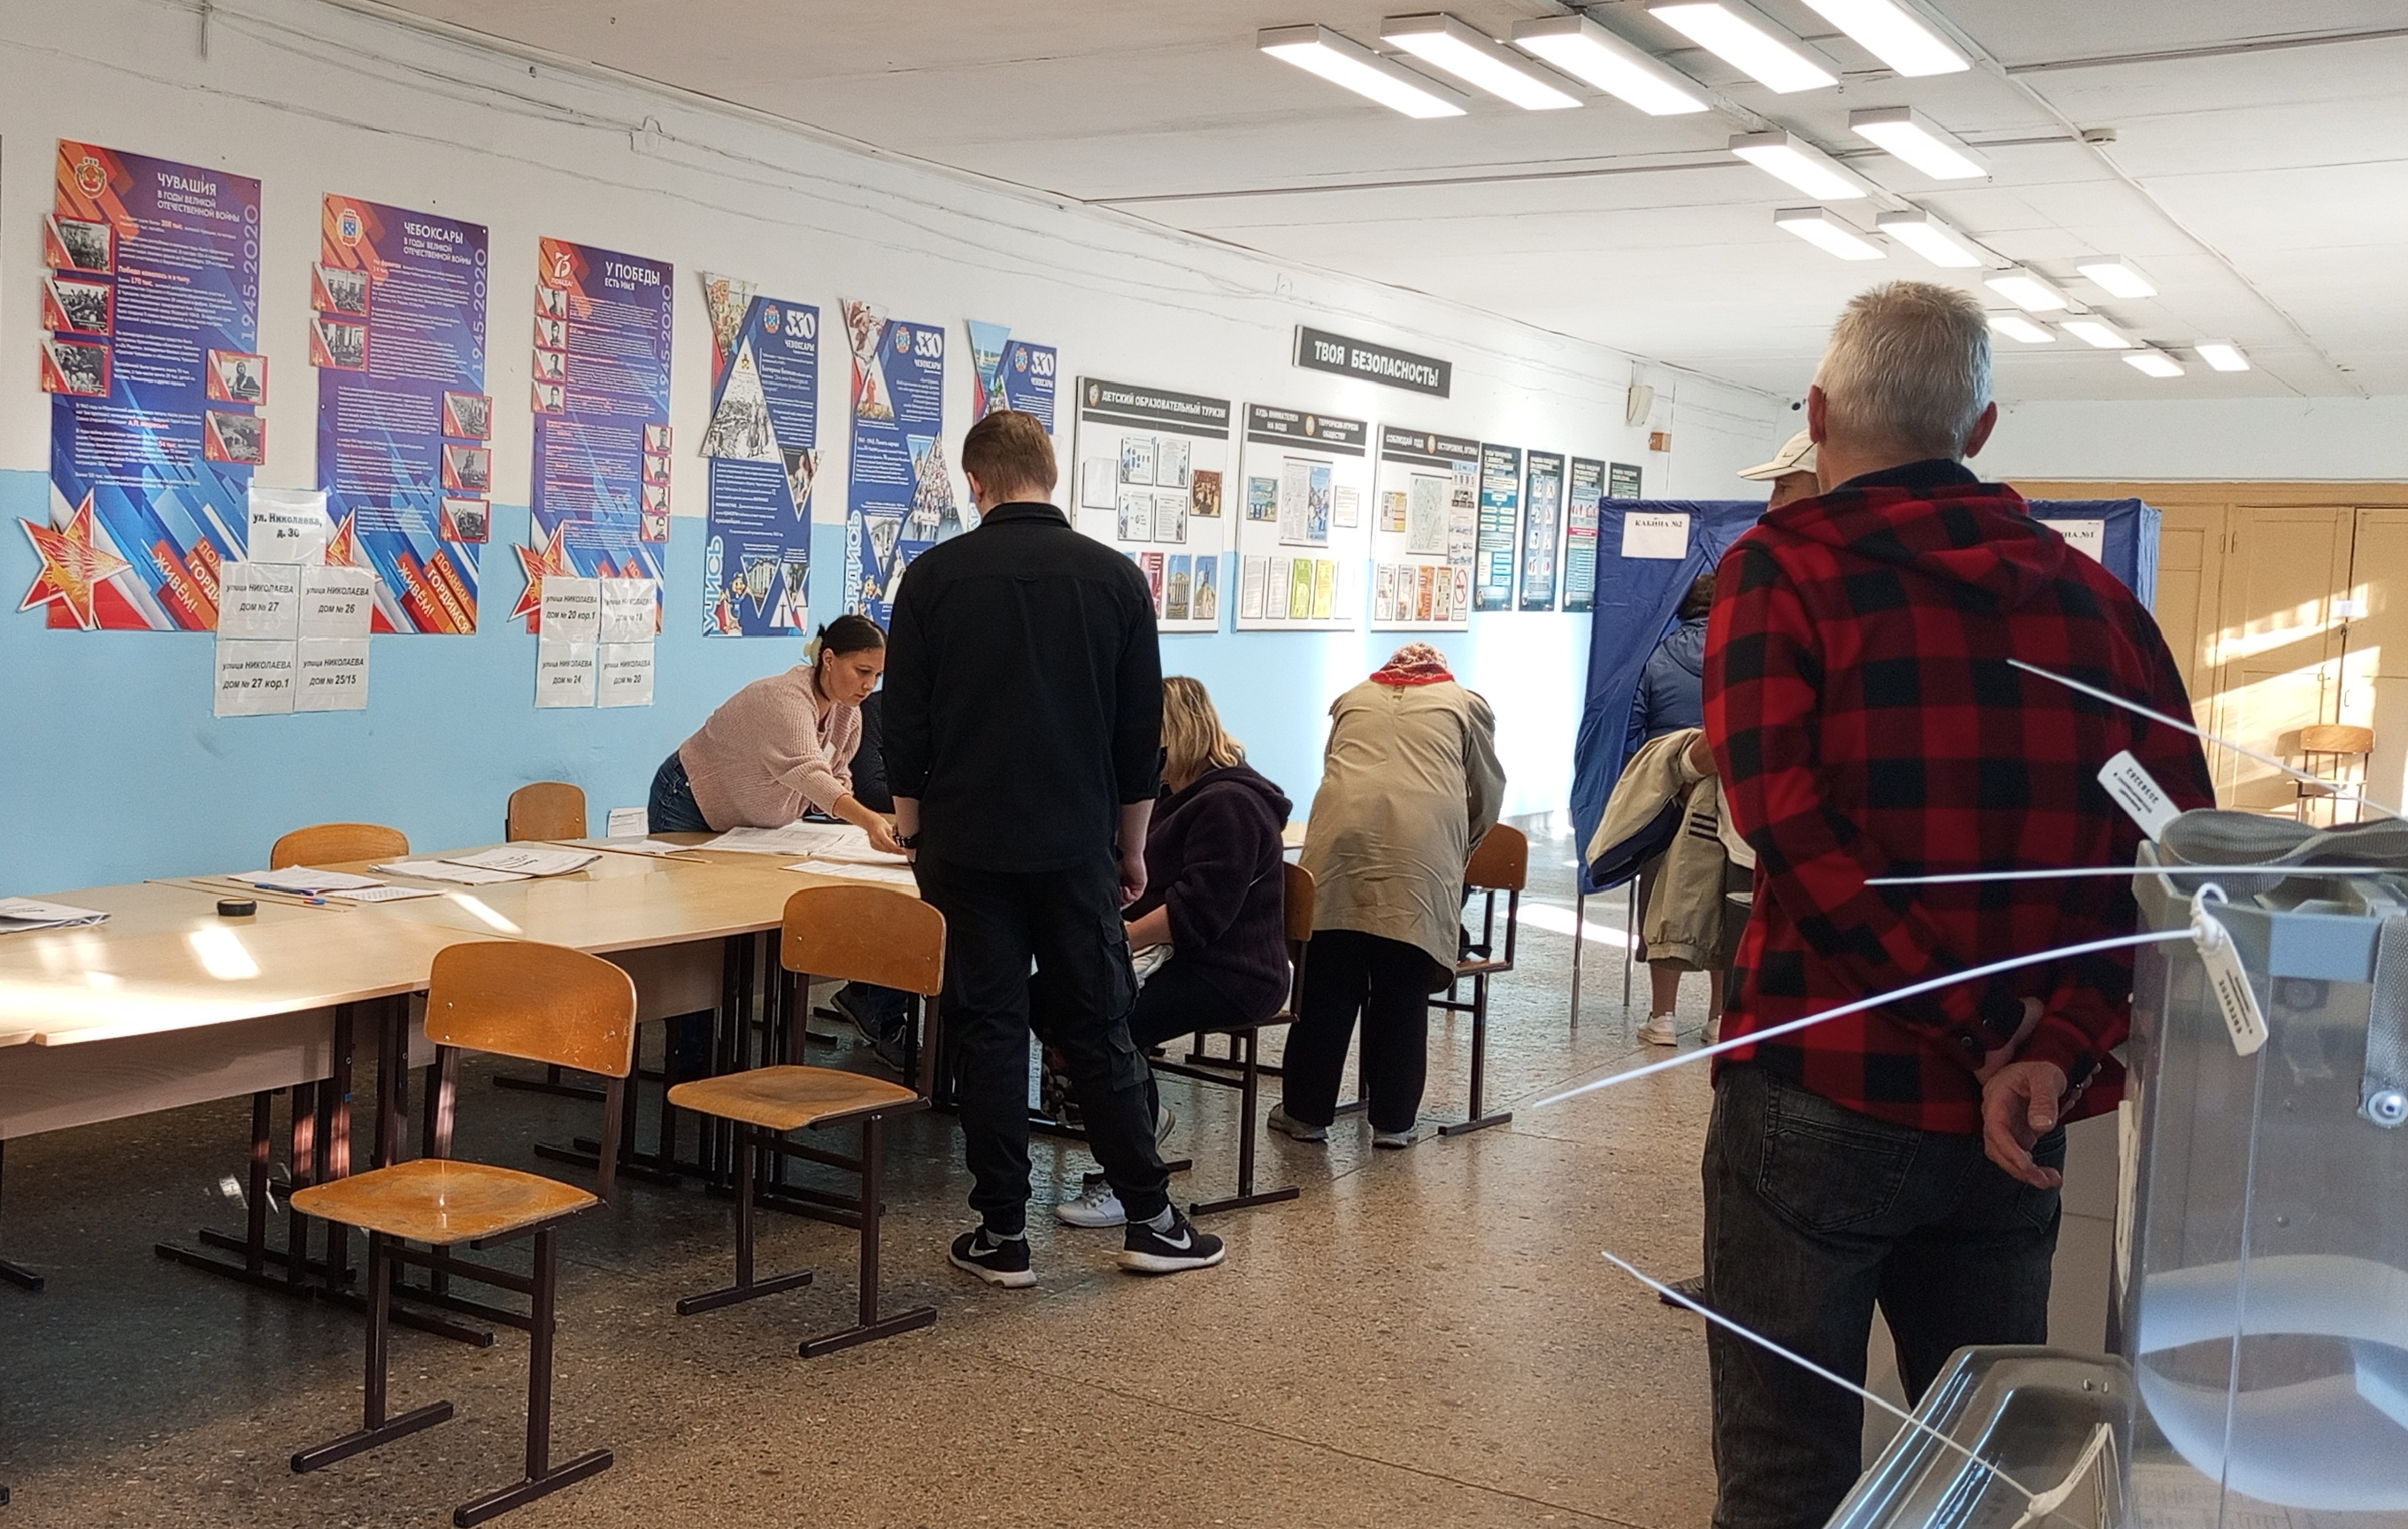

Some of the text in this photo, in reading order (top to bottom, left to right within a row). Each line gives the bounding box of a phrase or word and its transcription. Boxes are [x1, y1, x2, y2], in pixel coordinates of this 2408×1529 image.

[158, 173, 217, 196] ЧУВАШИЯ
[164, 190, 183, 202] ГОДЫ
[184, 195, 217, 208] ВЕЛИКОЙ
[158, 200, 241, 222] ОТЕЧЕСТВЕННОЙ ВОЙНЫ
[404, 221, 464, 244] ЧЕБОКСАРЫ
[409, 238, 426, 248] ГОДЫ
[427, 241, 453, 253] ВЕЛИКОЙ
[404, 246, 472, 265] ОТЕЧЕСТВЕННОЙ ВОЙНЫ
[241, 204, 259, 342] 1945-2020
[605, 261, 660, 287] У ПОБЕДЫ
[604, 277, 635, 291] ЕСТЬ ИМЯ
[472, 249, 487, 373] 1945-2020
[785, 310, 816, 340] 550
[659, 284, 672, 396] 1945-2020
[914, 330, 942, 358] 550
[1031, 350, 1055, 376] 550
[1314, 341, 1439, 388] ТВОЯ БЕЗОПАСНОСТЬ!
[1102, 390, 1227, 419] ДЕТСКИЙ ОБРАЗОВАТЕЛЬНЫЙ ТУРИЗМ
[252, 513, 323, 528] ул. Николаева,
[277, 528, 300, 539] д. 30
[844, 509, 863, 616] ОРДИСЬ
[153, 550, 198, 613] ЖИВЁМ!
[435, 551, 469, 604] ПОМНИМ
[703, 535, 724, 634] УЧИСЬ
[249, 584, 294, 594] НИКОЛАЕВА
[326, 586, 370, 596] НИКОЛАЕВА
[397, 562, 435, 619] ЖИВЁМ!
[239, 603, 256, 612] ДОМ
[268, 602, 280, 612] 27
[318, 604, 335, 614] ДОМ
[344, 603, 356, 614] 26
[427, 568, 469, 634] ГОРДИМСЯ
[563, 595, 597, 603] НИКОЛАЕВА
[545, 611, 559, 619] ДОМ
[568, 611, 576, 619] 20
[245, 661, 292, 670] НИКОЛАЕВА
[303, 660, 323, 669] улица
[620, 659, 650, 668] НИКОЛАЕВА
[222, 680, 240, 690] ДОМ
[251, 678, 263, 688] 27
[265, 678, 289, 690] кор.1
[309, 677, 326, 687] ДОМ
[335, 674, 357, 685] 25/15
[573, 675, 581, 684] 24
[634, 674, 642, 684] 20
